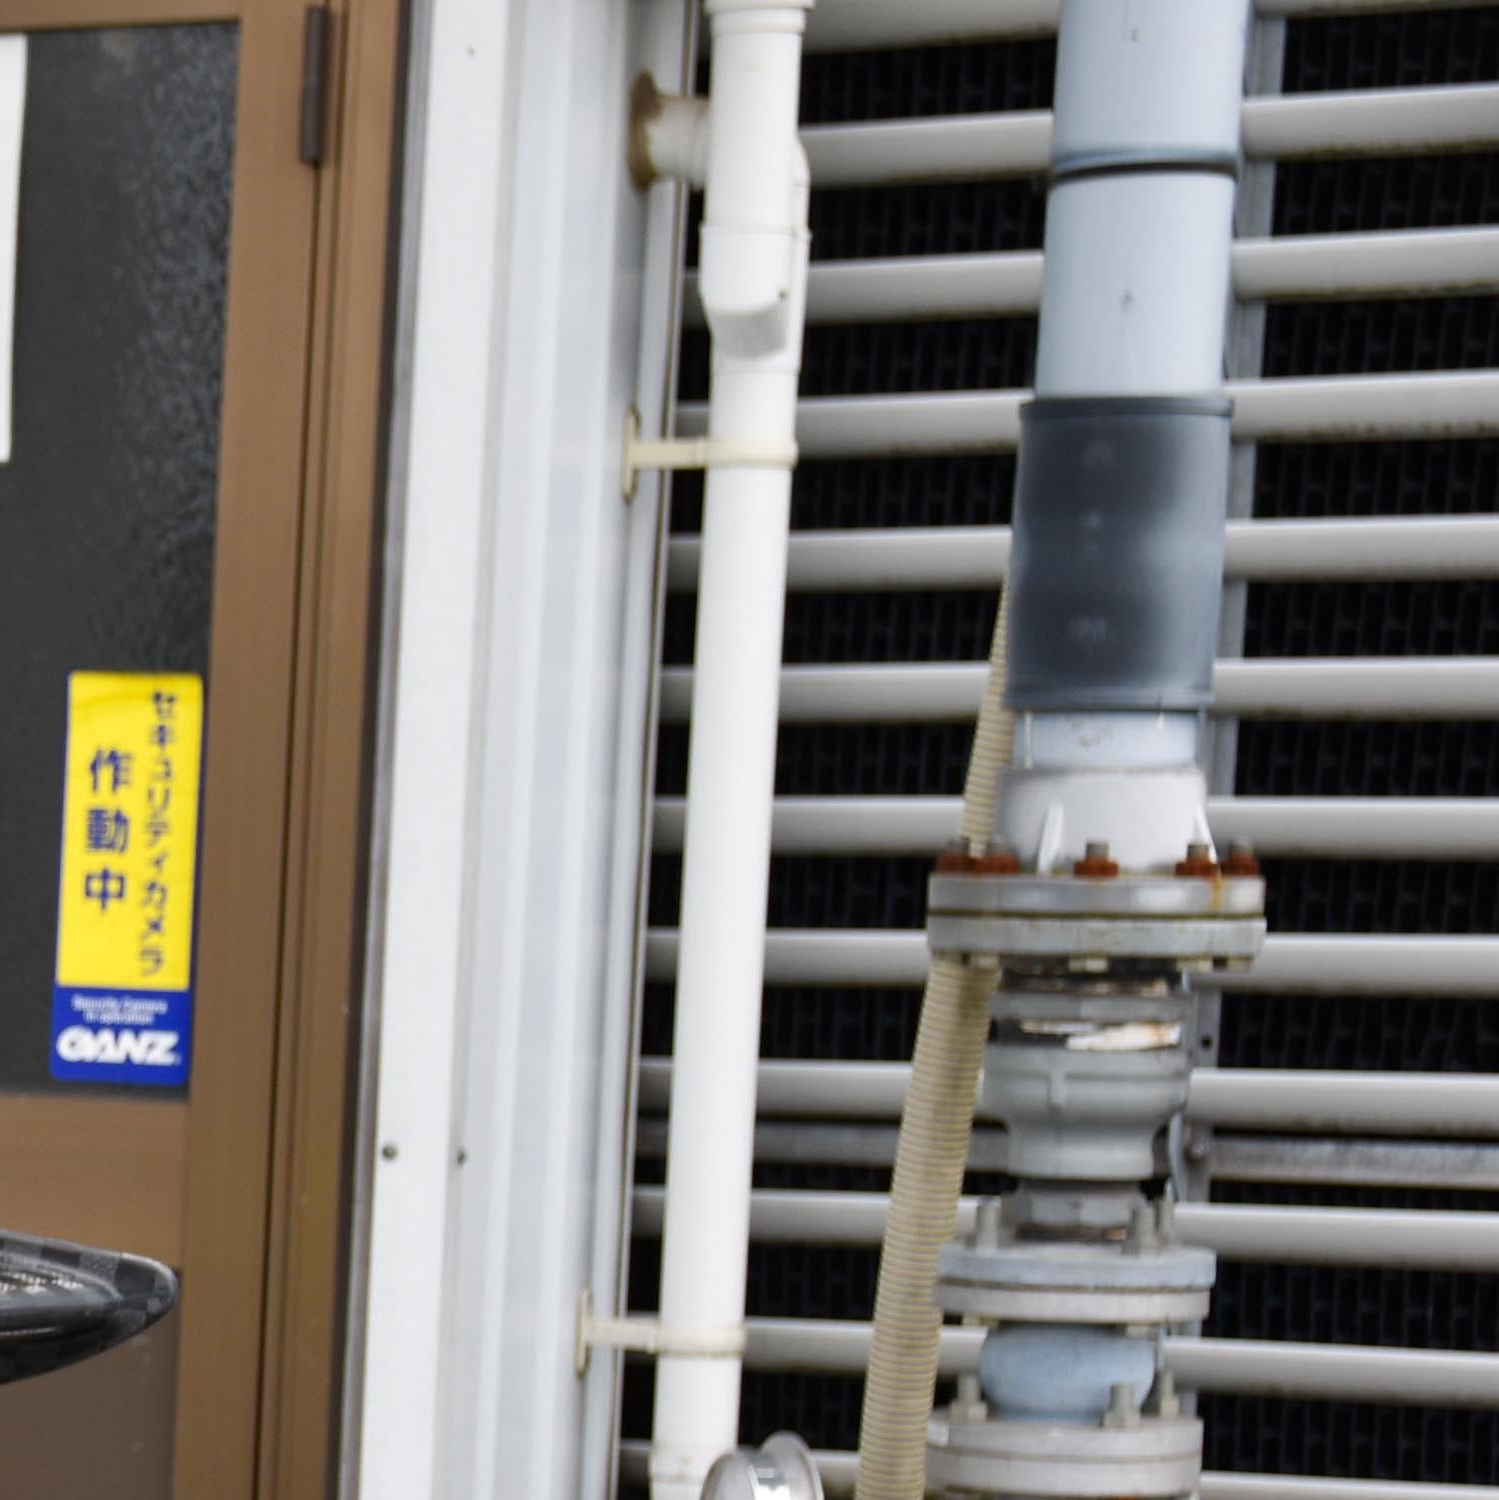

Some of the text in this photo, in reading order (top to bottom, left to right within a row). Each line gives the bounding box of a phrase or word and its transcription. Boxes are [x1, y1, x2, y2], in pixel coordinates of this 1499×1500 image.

[83, 744, 134, 912] 作動中
[138, 691, 178, 976] セキュリティカメラ
